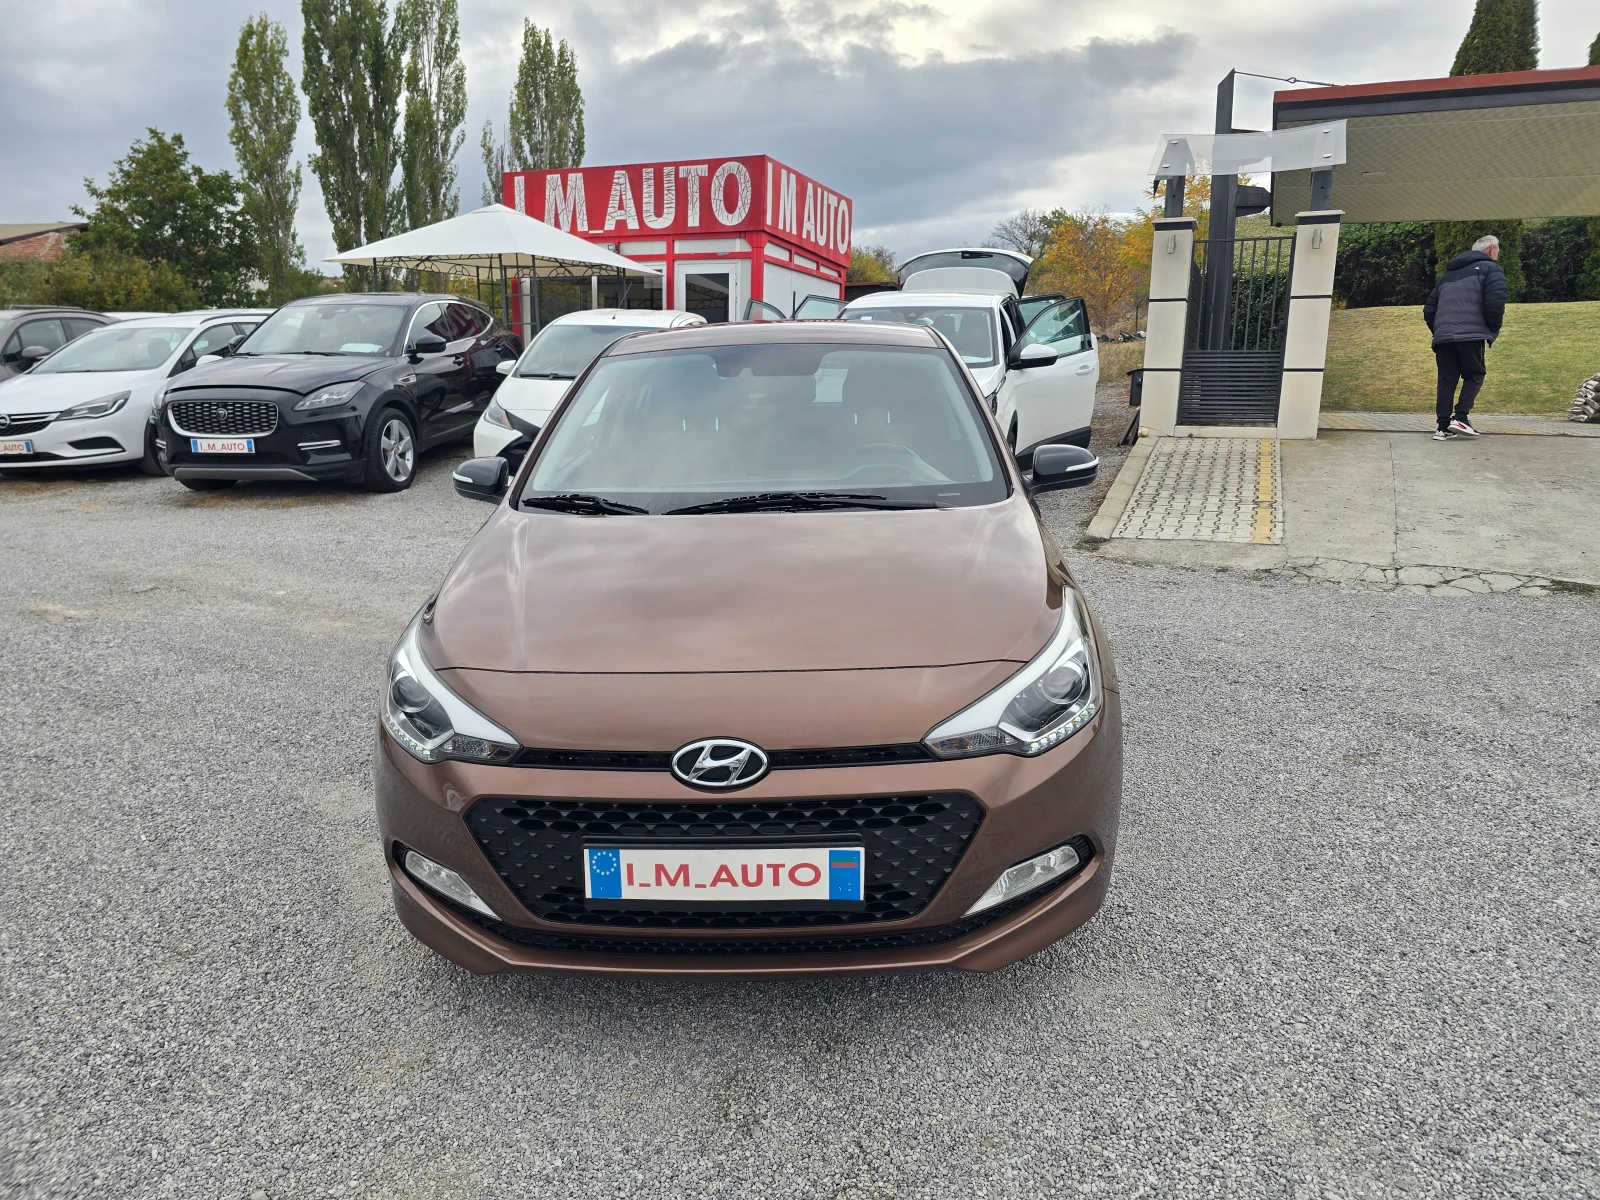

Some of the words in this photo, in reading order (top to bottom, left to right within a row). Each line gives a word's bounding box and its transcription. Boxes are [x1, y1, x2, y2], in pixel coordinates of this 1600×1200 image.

[766, 161, 773, 227] I
[778, 168, 797, 236] M
[802, 182, 849, 255] AUTO
[626, 862, 821, 888] I_M_AUTO
